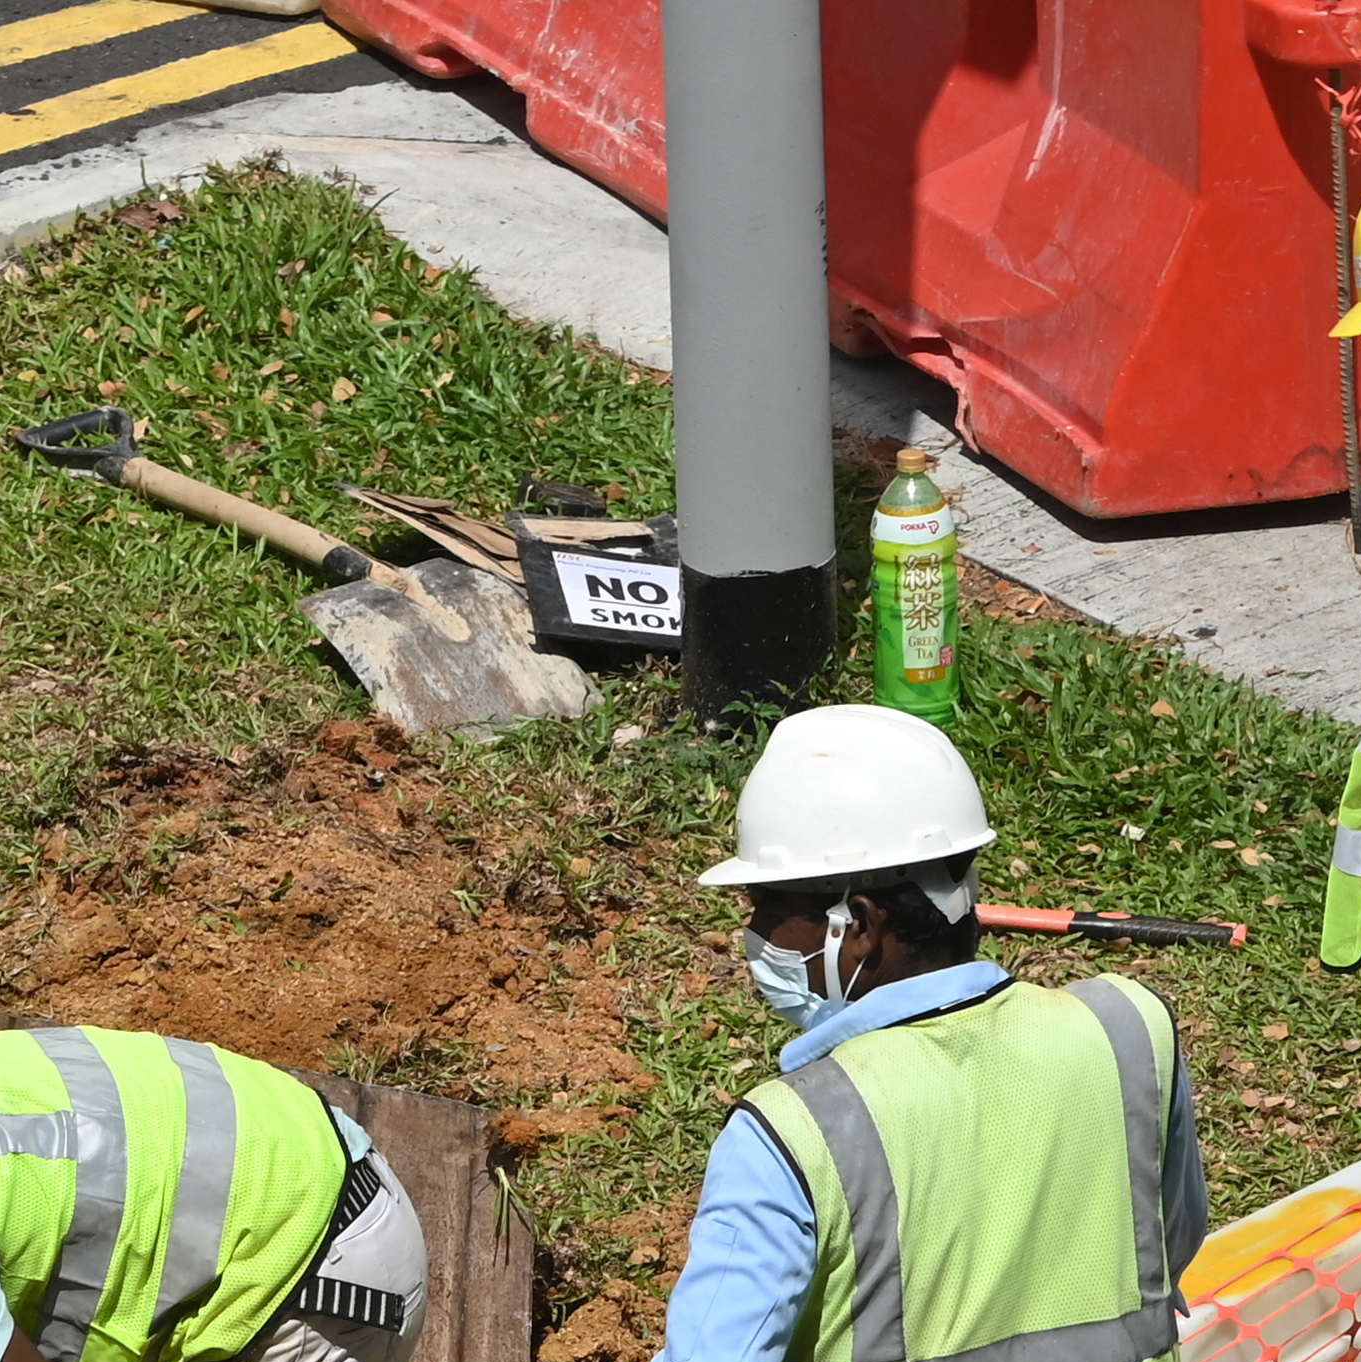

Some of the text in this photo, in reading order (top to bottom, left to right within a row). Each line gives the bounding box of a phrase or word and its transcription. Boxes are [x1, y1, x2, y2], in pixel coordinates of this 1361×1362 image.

[584, 573, 669, 605] NO
[908, 635, 940, 648] GREEN
[915, 648, 934, 660] TEA
